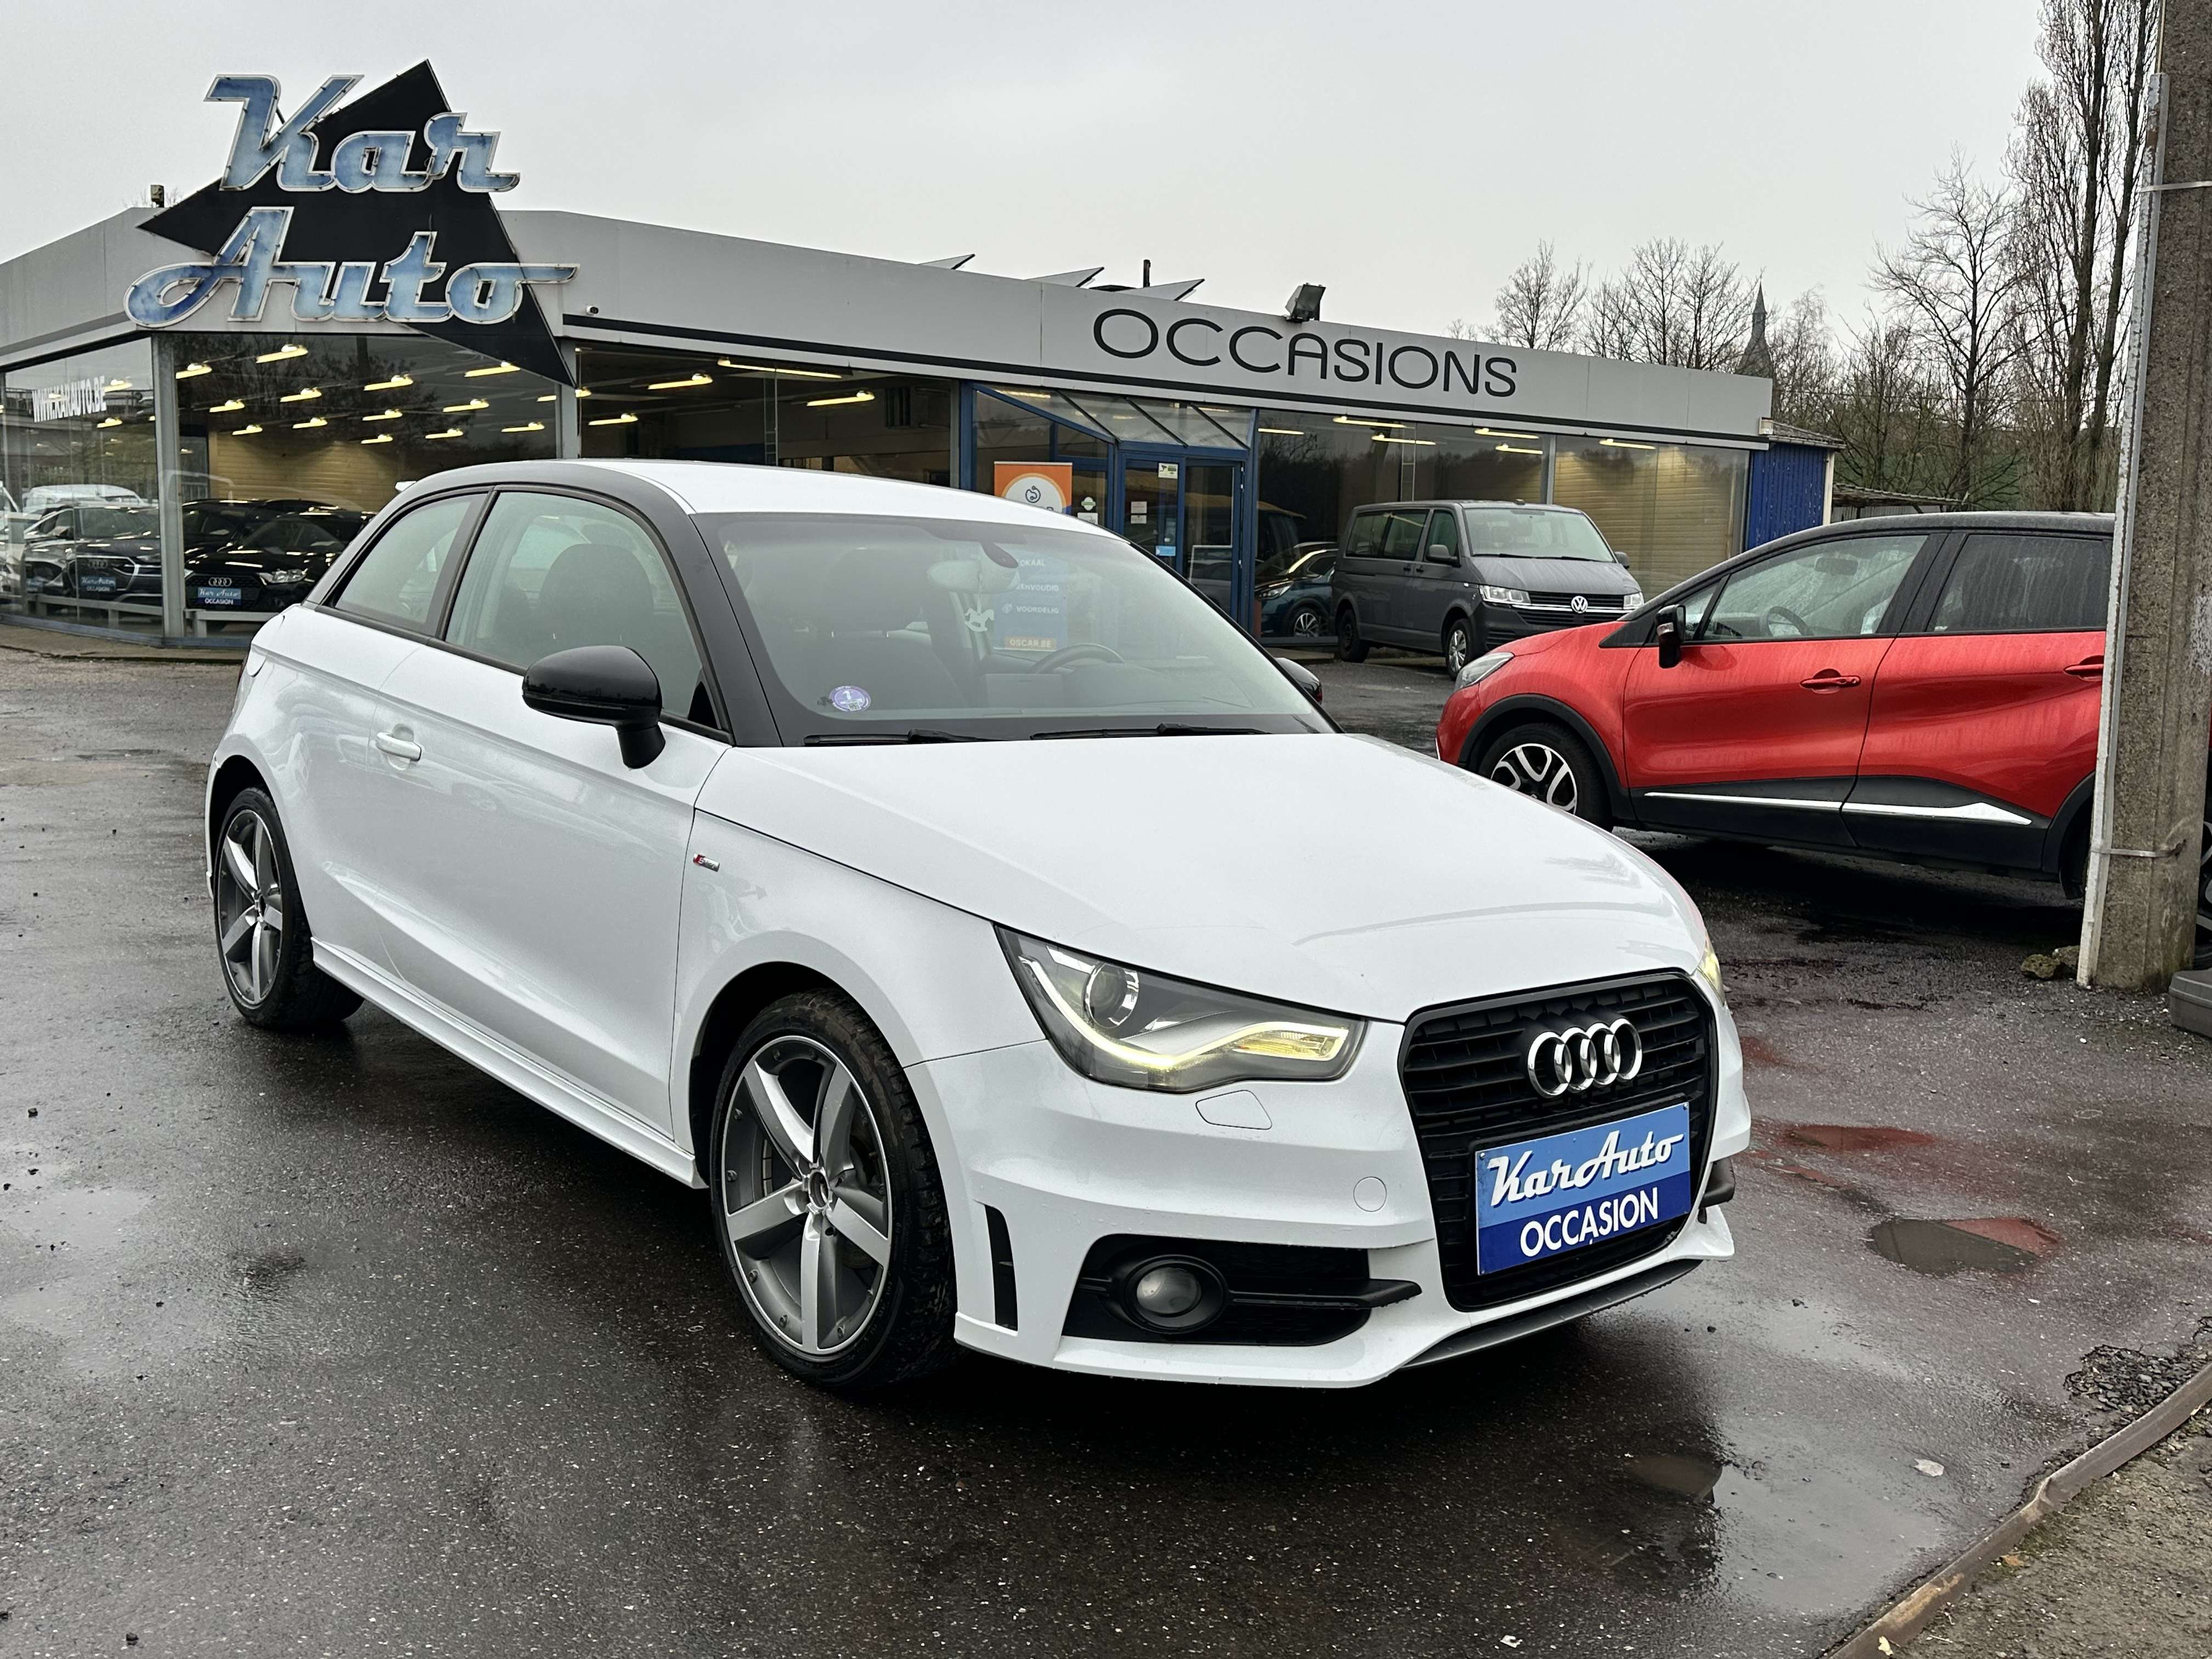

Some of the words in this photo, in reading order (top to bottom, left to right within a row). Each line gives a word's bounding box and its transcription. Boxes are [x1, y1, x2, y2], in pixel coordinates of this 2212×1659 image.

[204, 75, 521, 193] Kar
[123, 206, 581, 327] Auto
[1093, 308, 1517, 398] OCCASIONS
[1017, 558, 1046, 567] OKAAL
[1009, 639, 1052, 648] OSCAR.BE
[1017, 605, 1059, 614] VOORDELIG
[1520, 1187, 1658, 1257] OCCASION
